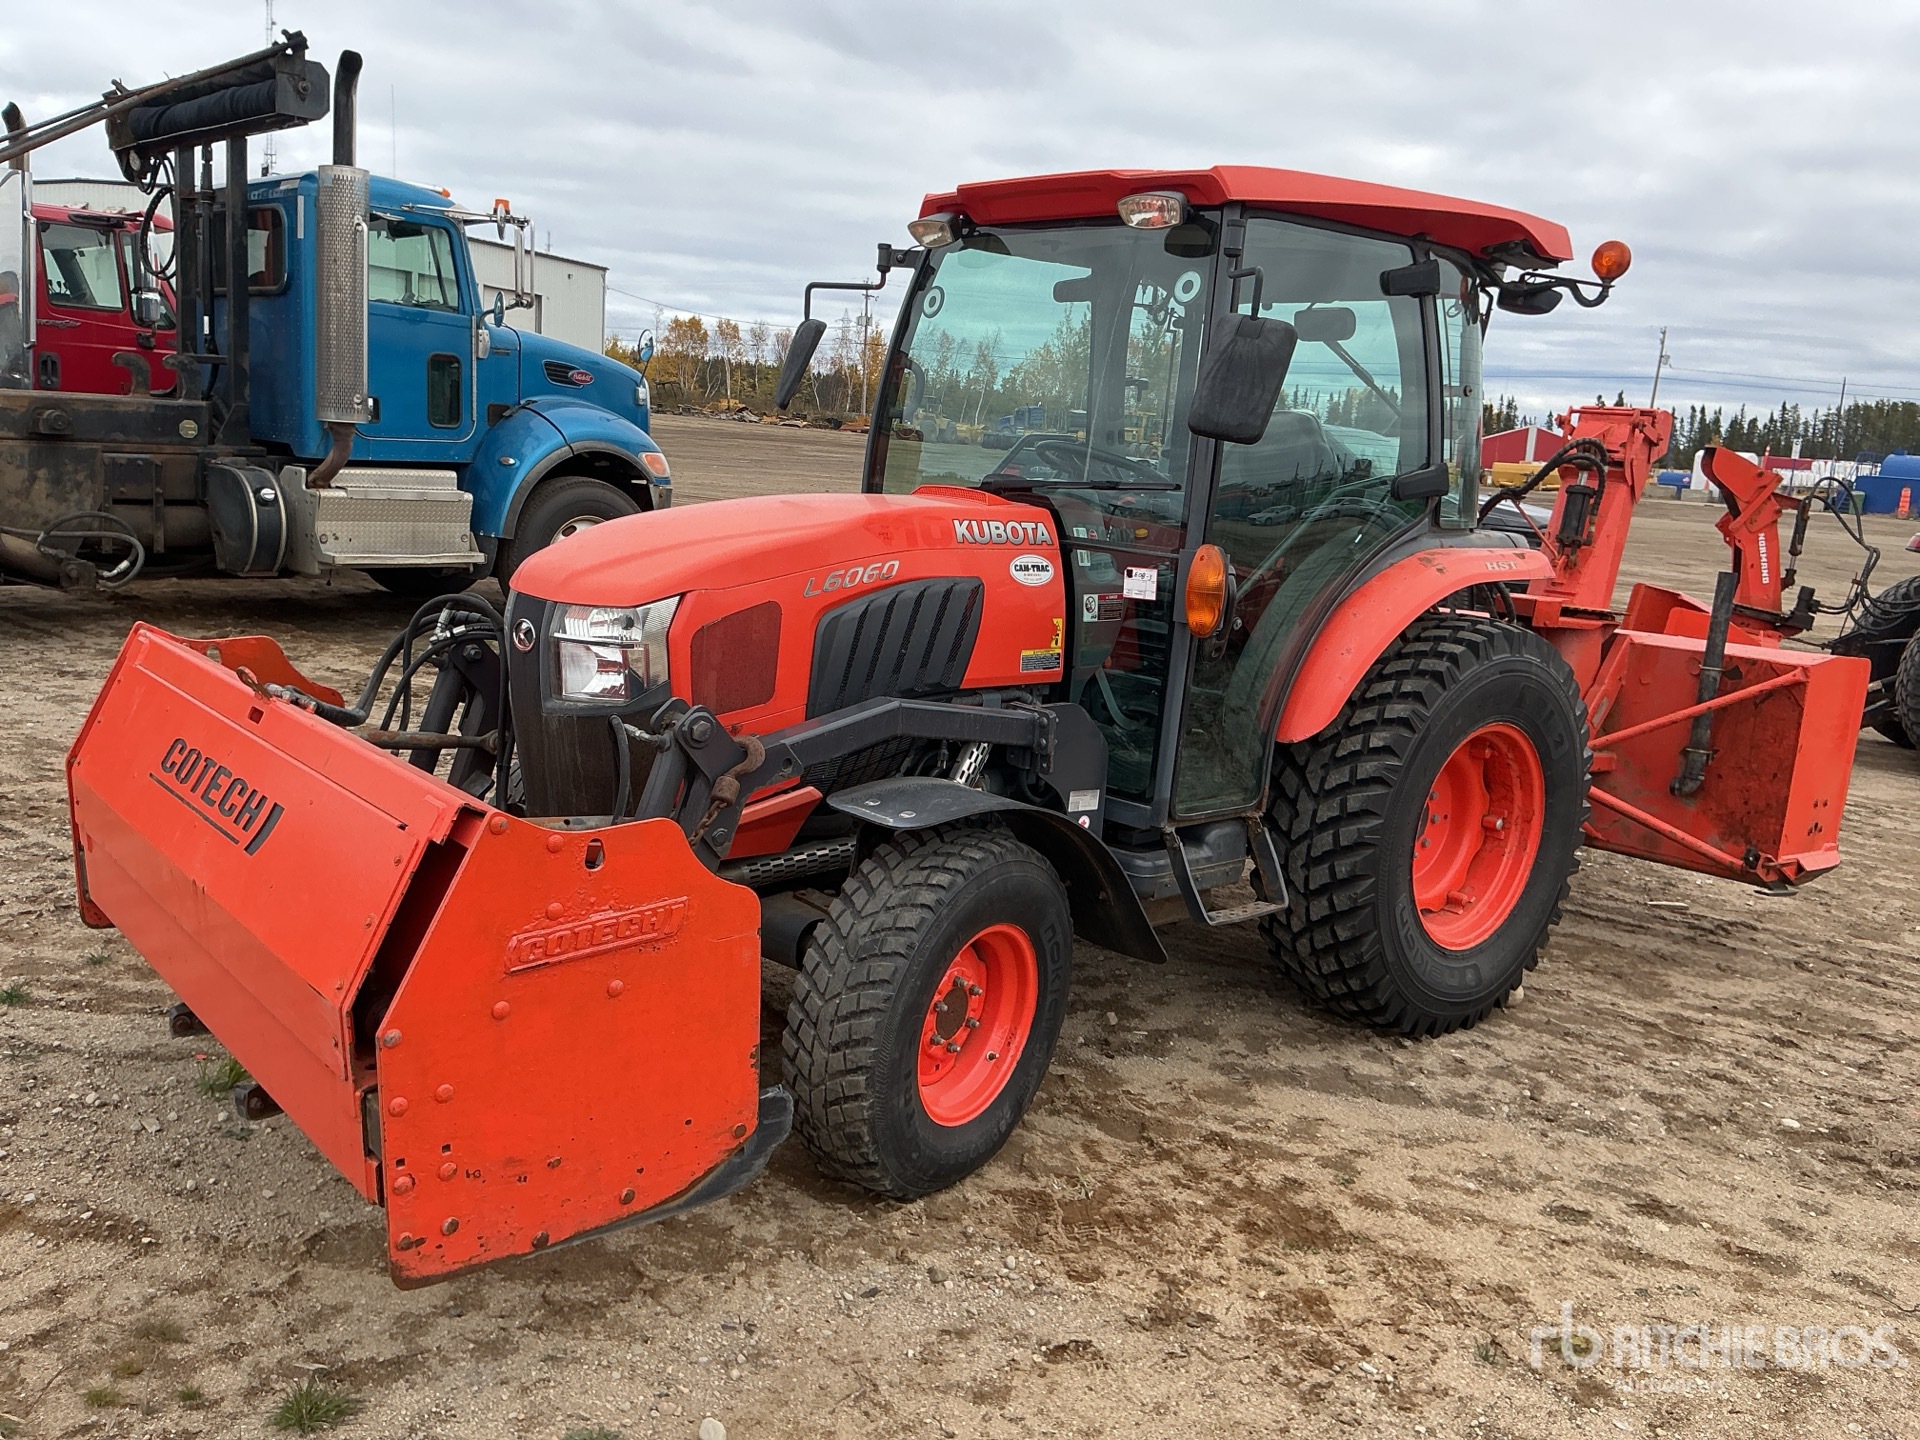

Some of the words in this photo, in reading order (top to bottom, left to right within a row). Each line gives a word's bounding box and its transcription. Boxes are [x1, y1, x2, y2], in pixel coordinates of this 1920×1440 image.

[953, 519, 1054, 546] KUBOTA
[802, 559, 900, 598] L6060
[1758, 533, 1770, 584] NORMAND
[161, 738, 268, 833] COTECH
[518, 906, 673, 963] COTECH
